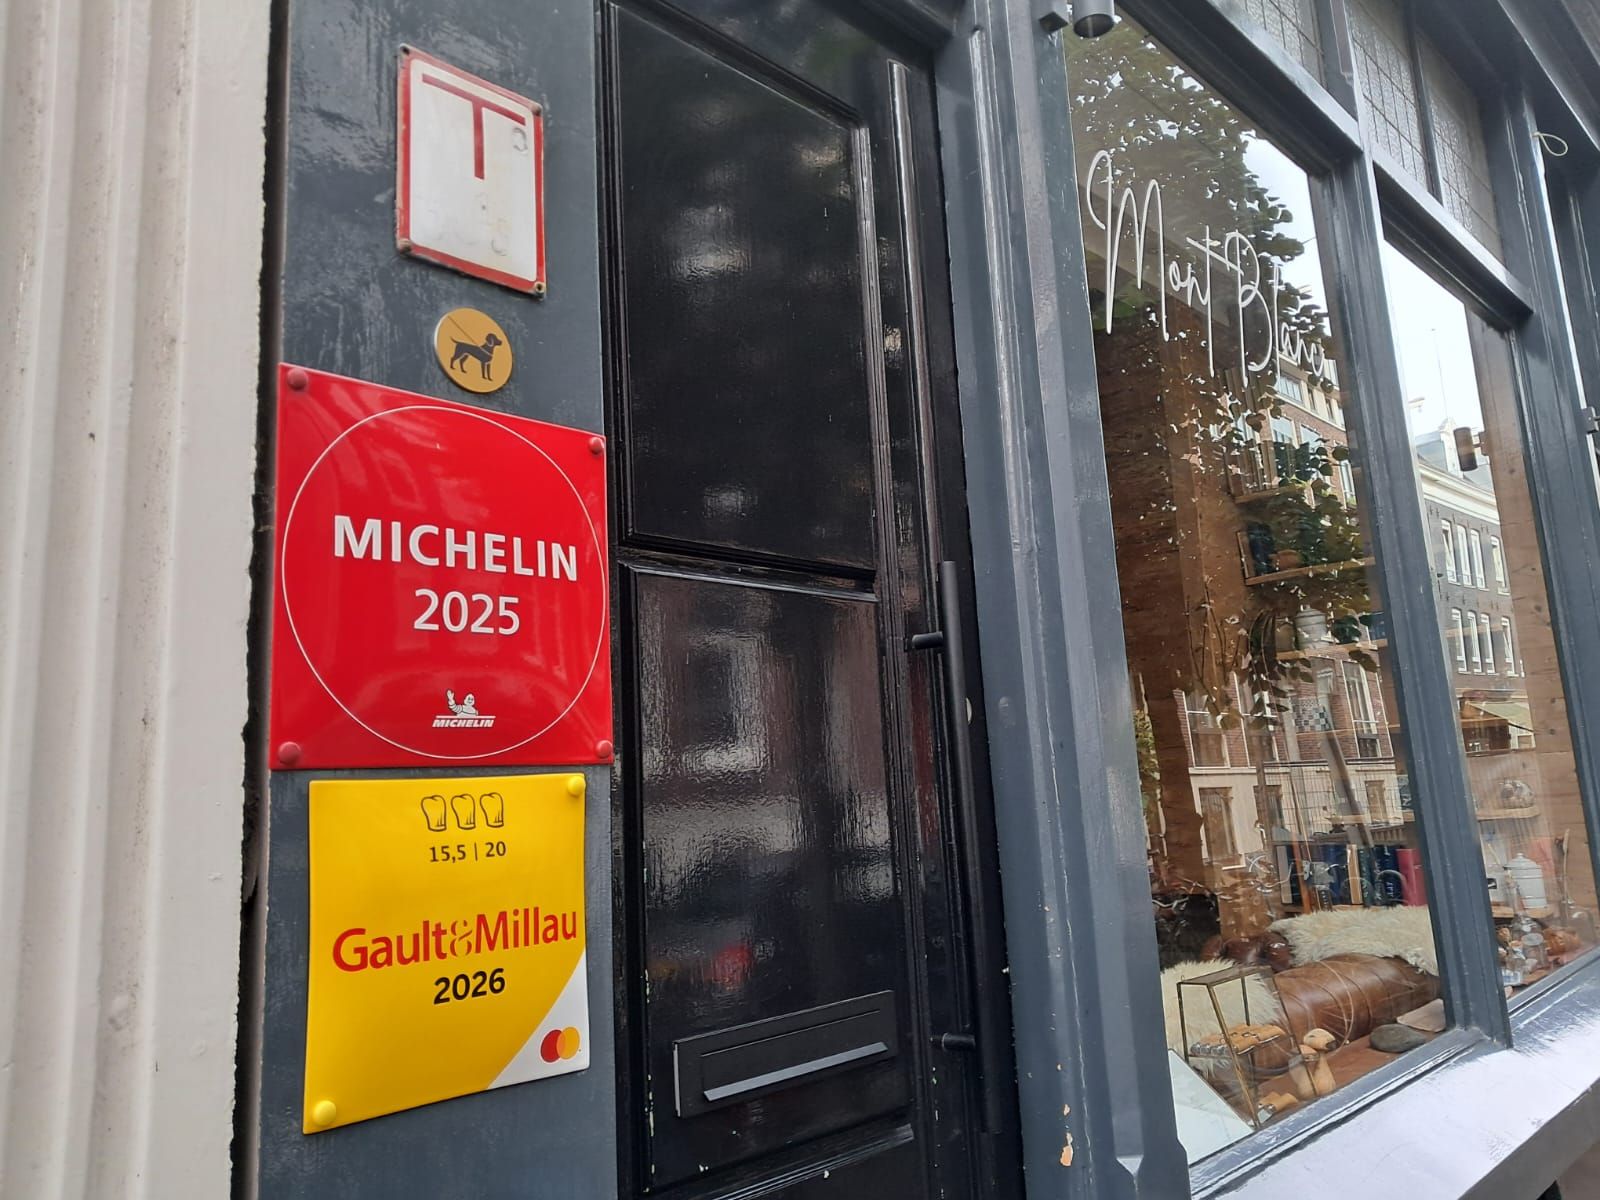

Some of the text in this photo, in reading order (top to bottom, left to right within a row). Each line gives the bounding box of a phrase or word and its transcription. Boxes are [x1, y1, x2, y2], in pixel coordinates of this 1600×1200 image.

[1086, 149, 1244, 378] Mont
[333, 515, 578, 582] MICHELIN
[413, 589, 520, 636] 2025
[432, 719, 495, 728] MICHELIN
[429, 844, 467, 864] 15,5
[485, 841, 507, 858] 20
[332, 906, 578, 973] Gault&Millau
[433, 968, 506, 1005] 2026
